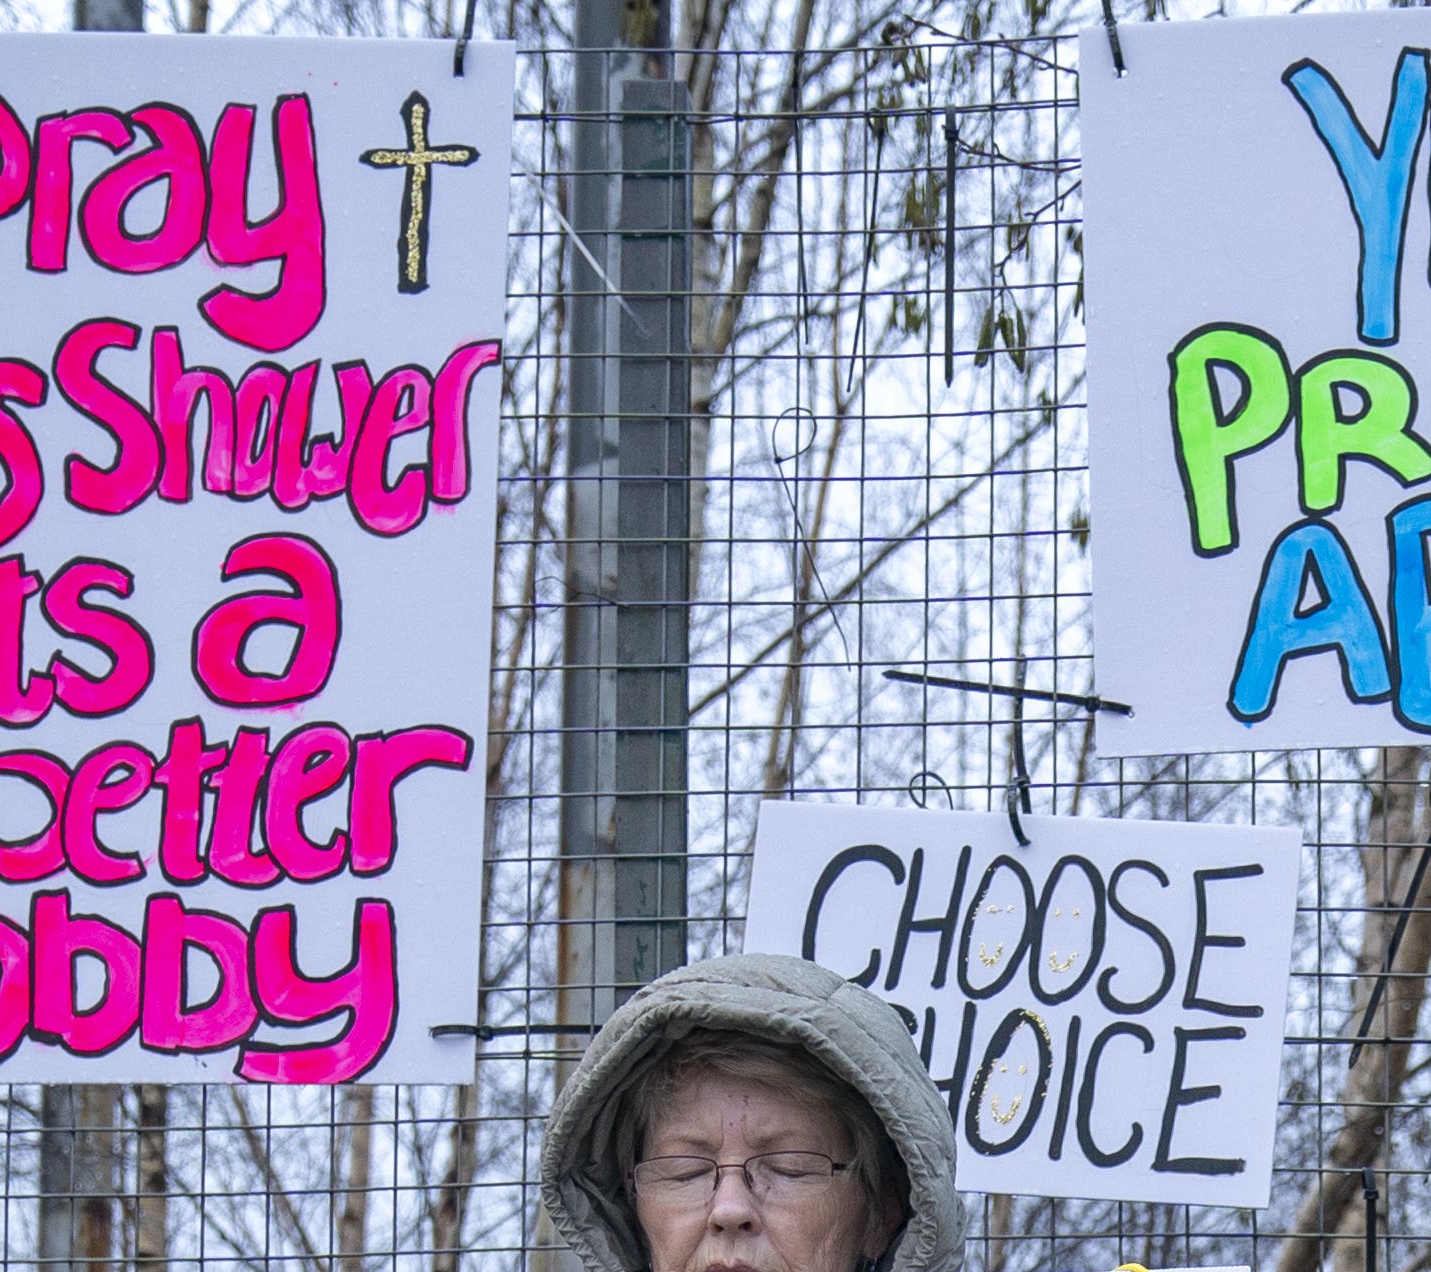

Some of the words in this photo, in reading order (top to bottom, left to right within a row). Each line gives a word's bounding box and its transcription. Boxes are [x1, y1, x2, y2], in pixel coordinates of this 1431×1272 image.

[191, 532, 342, 708] a
[802, 845, 1263, 1017] CHOOSE
[891, 1003, 1246, 1174] HOICE
